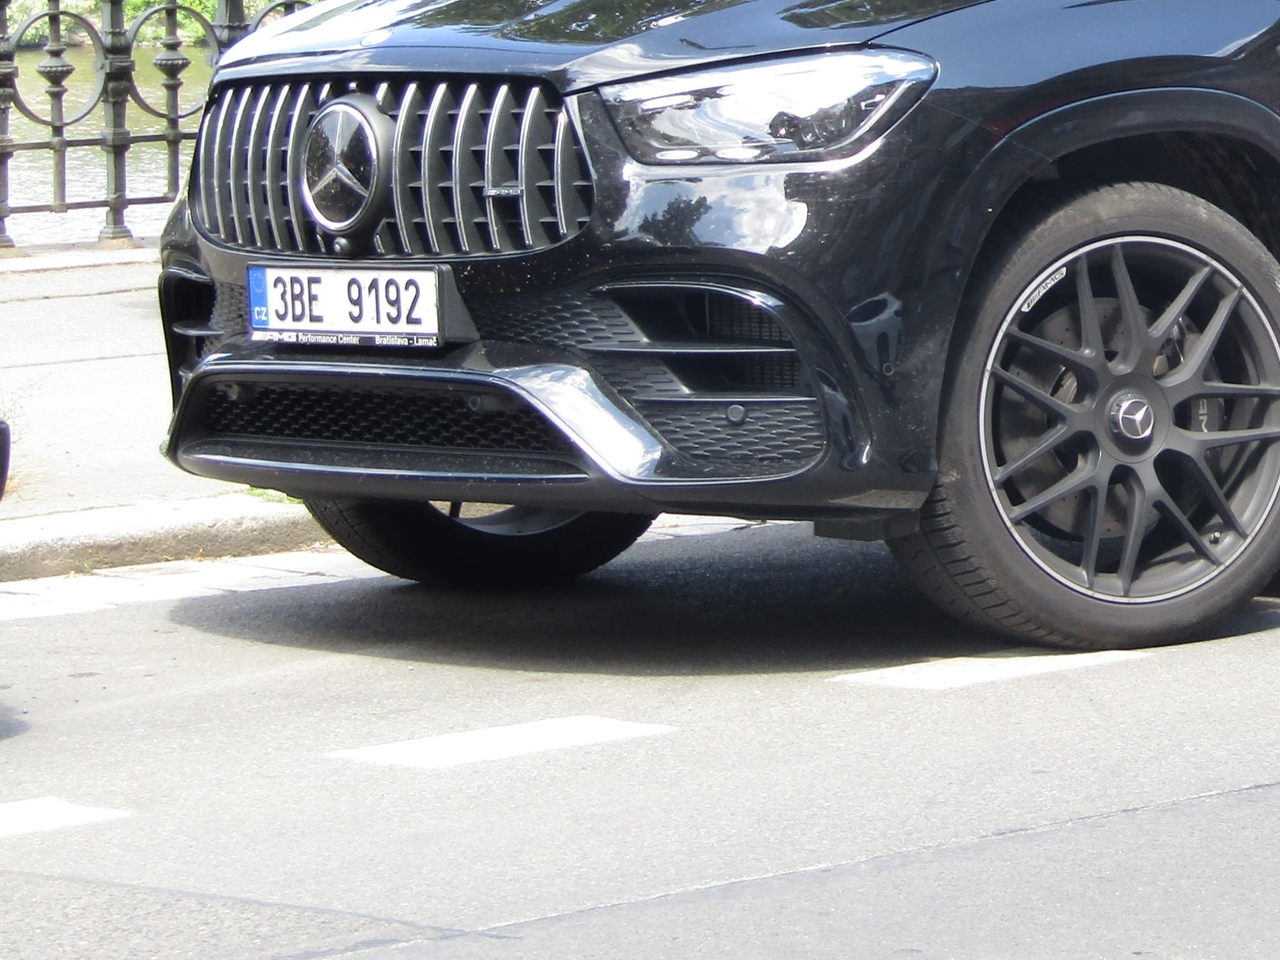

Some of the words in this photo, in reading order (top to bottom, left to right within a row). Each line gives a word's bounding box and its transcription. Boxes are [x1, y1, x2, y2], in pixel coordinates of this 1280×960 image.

[1031, 270, 1064, 303] AMG
[273, 276, 324, 323] 3BE
[347, 277, 423, 325] 9192
[254, 307, 268, 321] CZ
[298, 333, 337, 344] Performance
[338, 334, 360, 345] Center
[375, 335, 409, 346] Bratislava
[414, 335, 438, 347] Lamač
